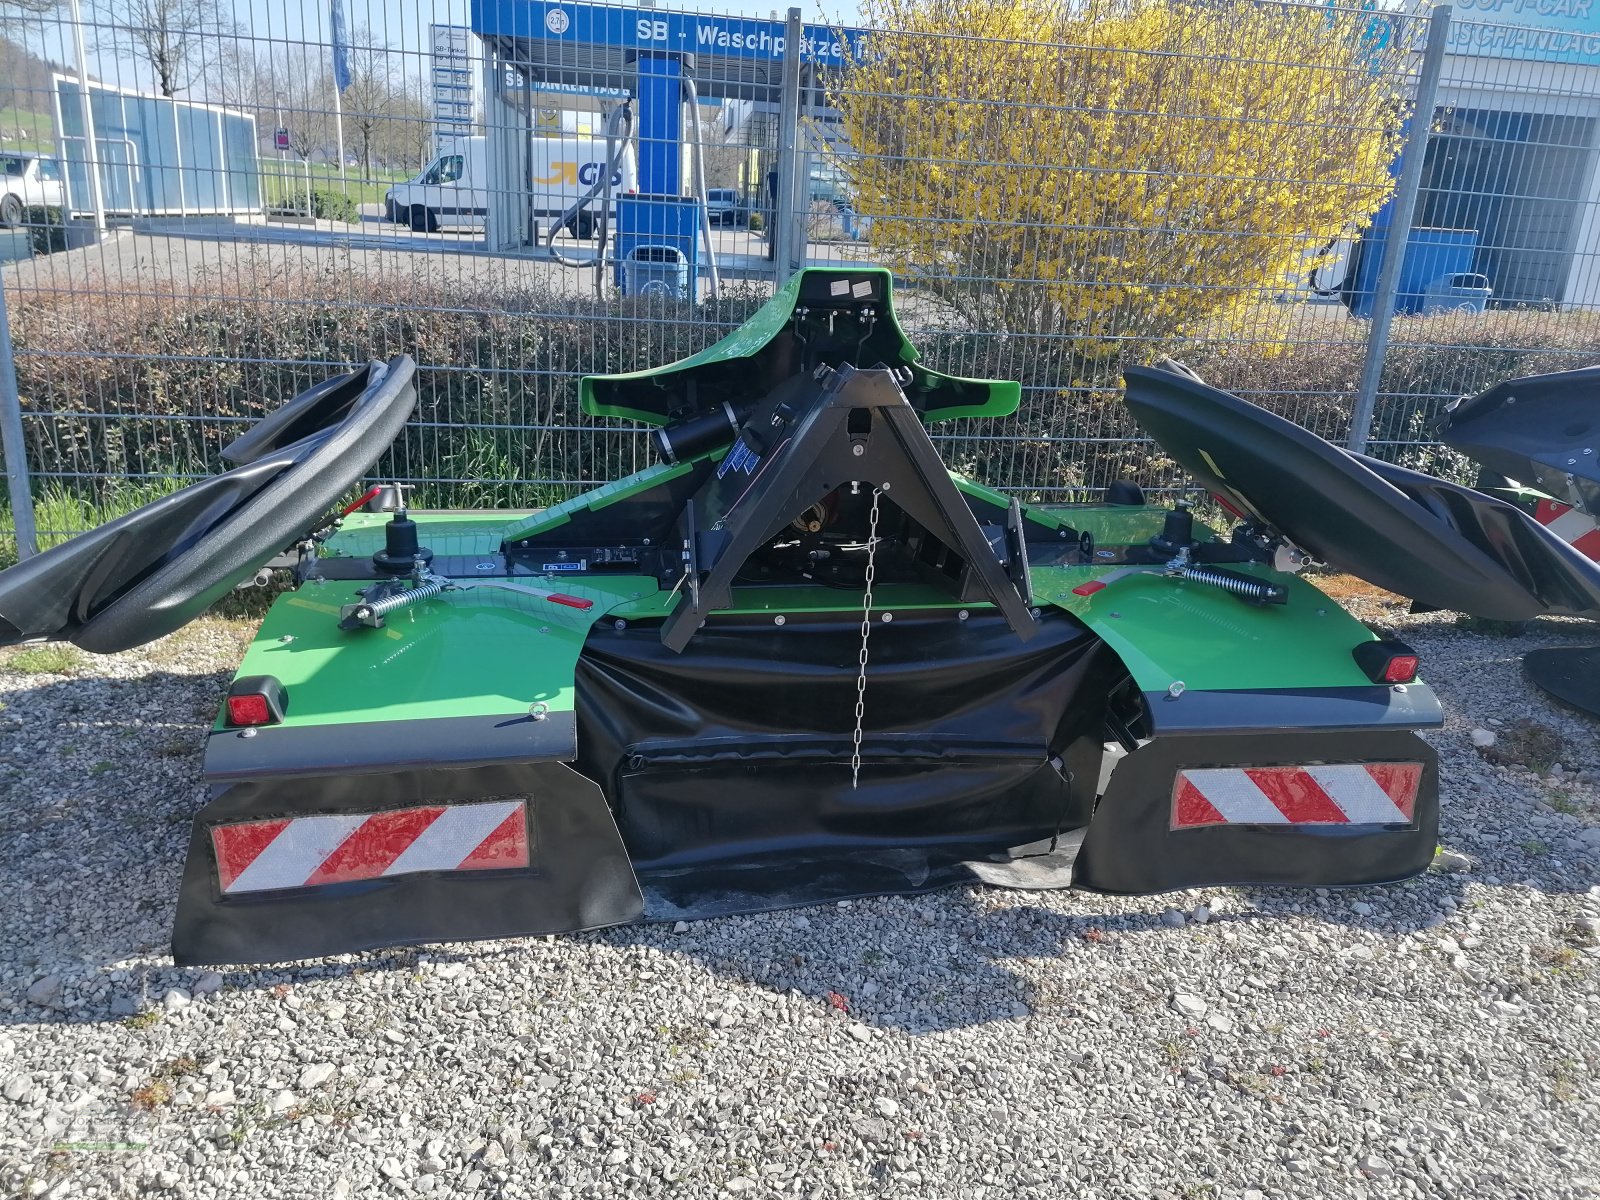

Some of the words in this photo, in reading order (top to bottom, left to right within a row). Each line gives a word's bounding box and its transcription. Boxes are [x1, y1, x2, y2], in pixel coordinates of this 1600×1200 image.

[637, 20, 669, 41] SB
[697, 25, 843, 57] Waschpätze
[505, 72, 524, 87] SB
